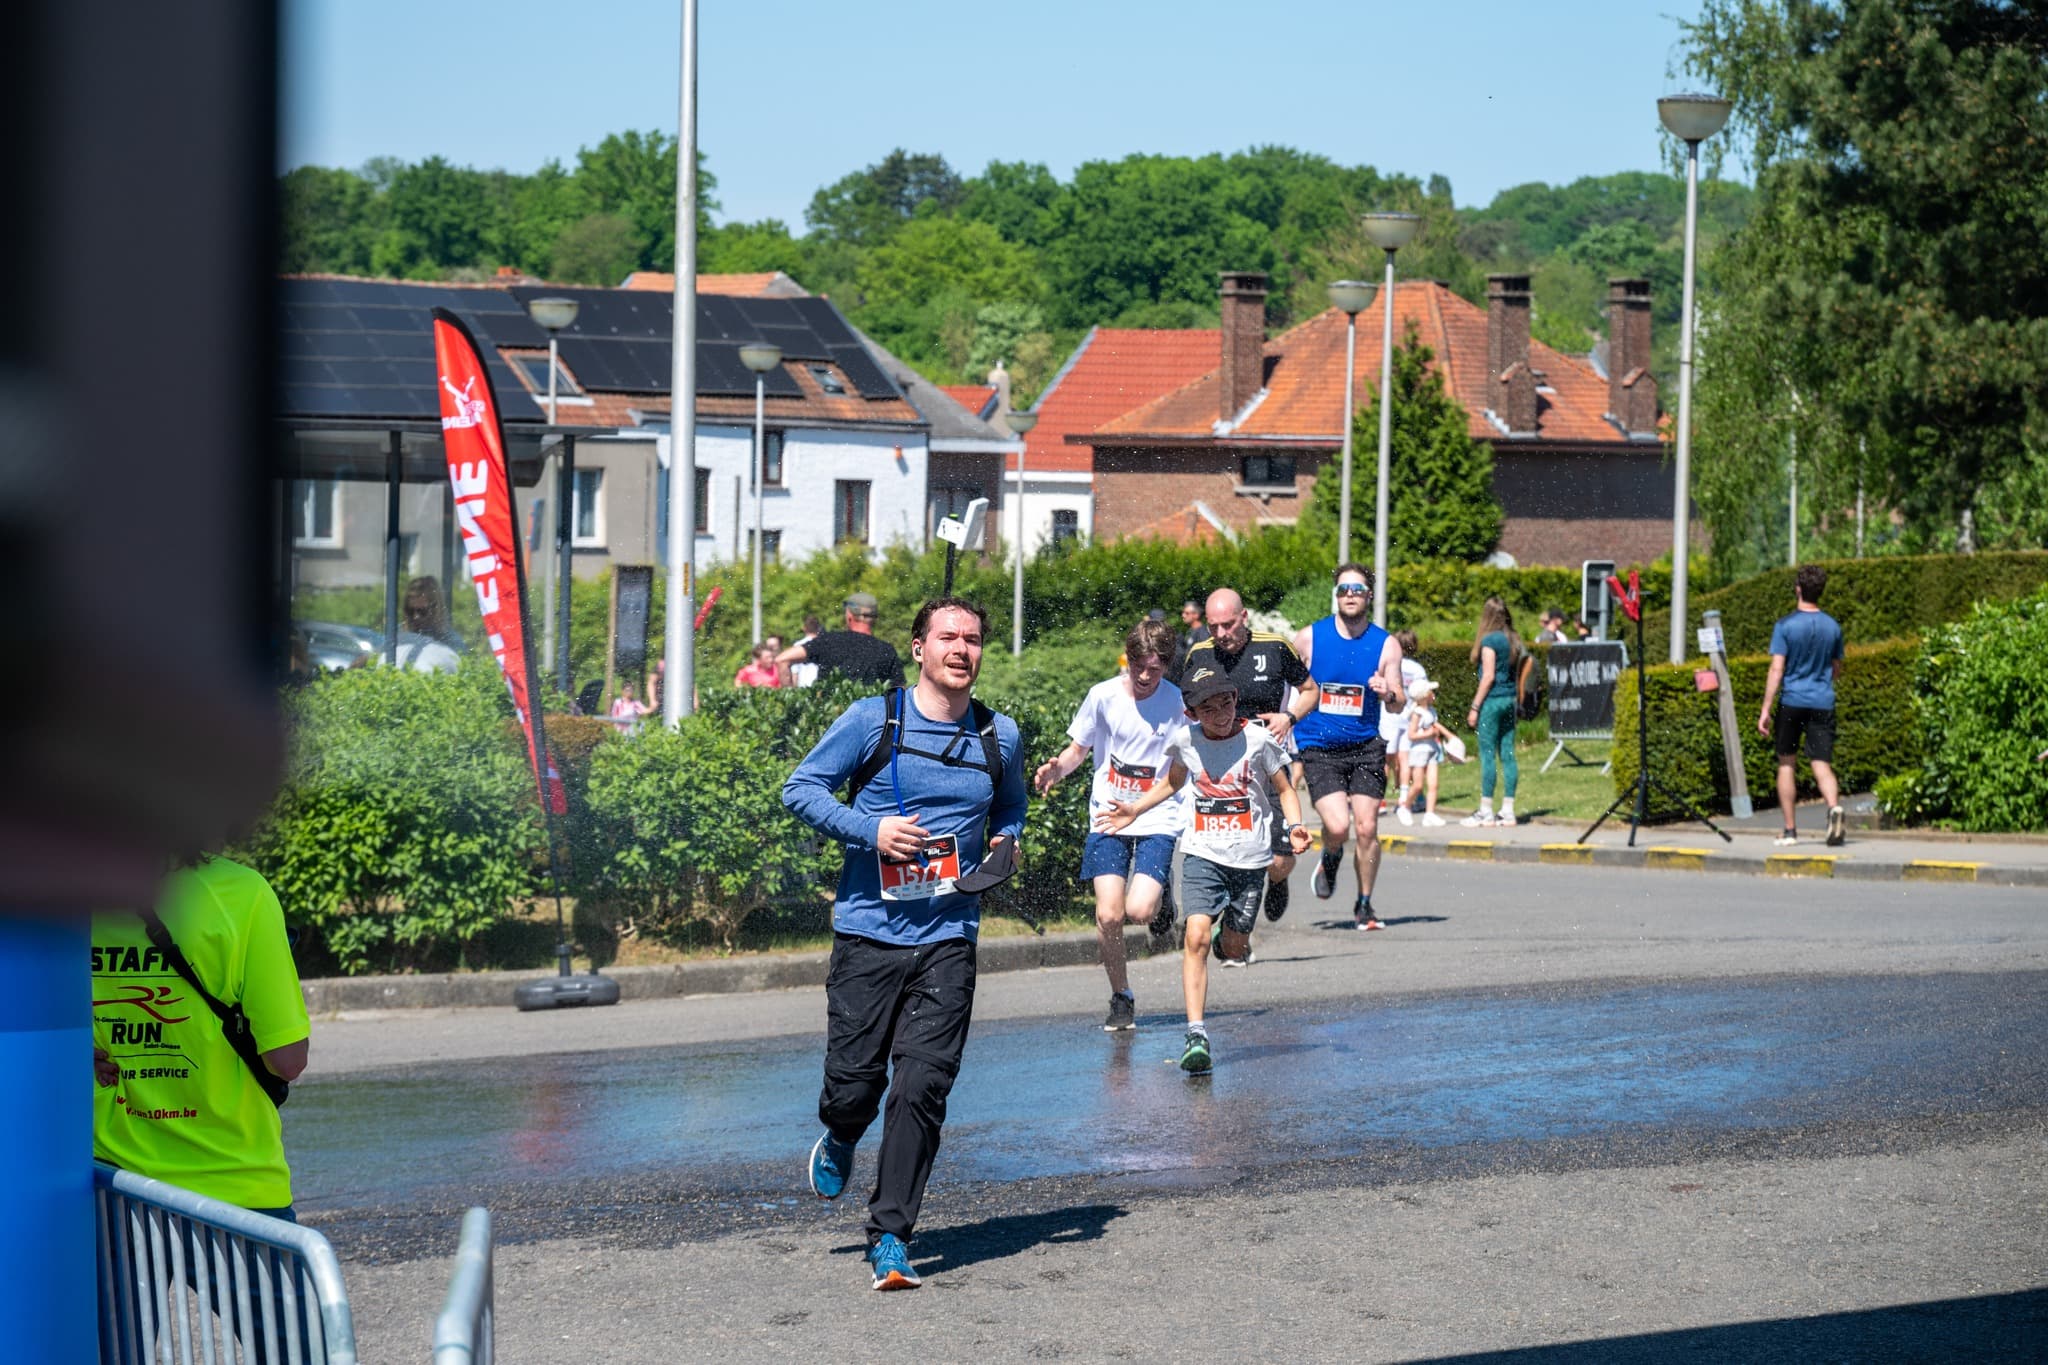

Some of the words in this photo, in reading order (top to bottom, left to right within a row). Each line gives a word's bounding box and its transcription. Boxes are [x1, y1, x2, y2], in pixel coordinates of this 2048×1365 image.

[1203, 816, 1241, 832] 1856
[111, 1023, 162, 1044] RUN
[140, 1068, 189, 1079] SERVICE
